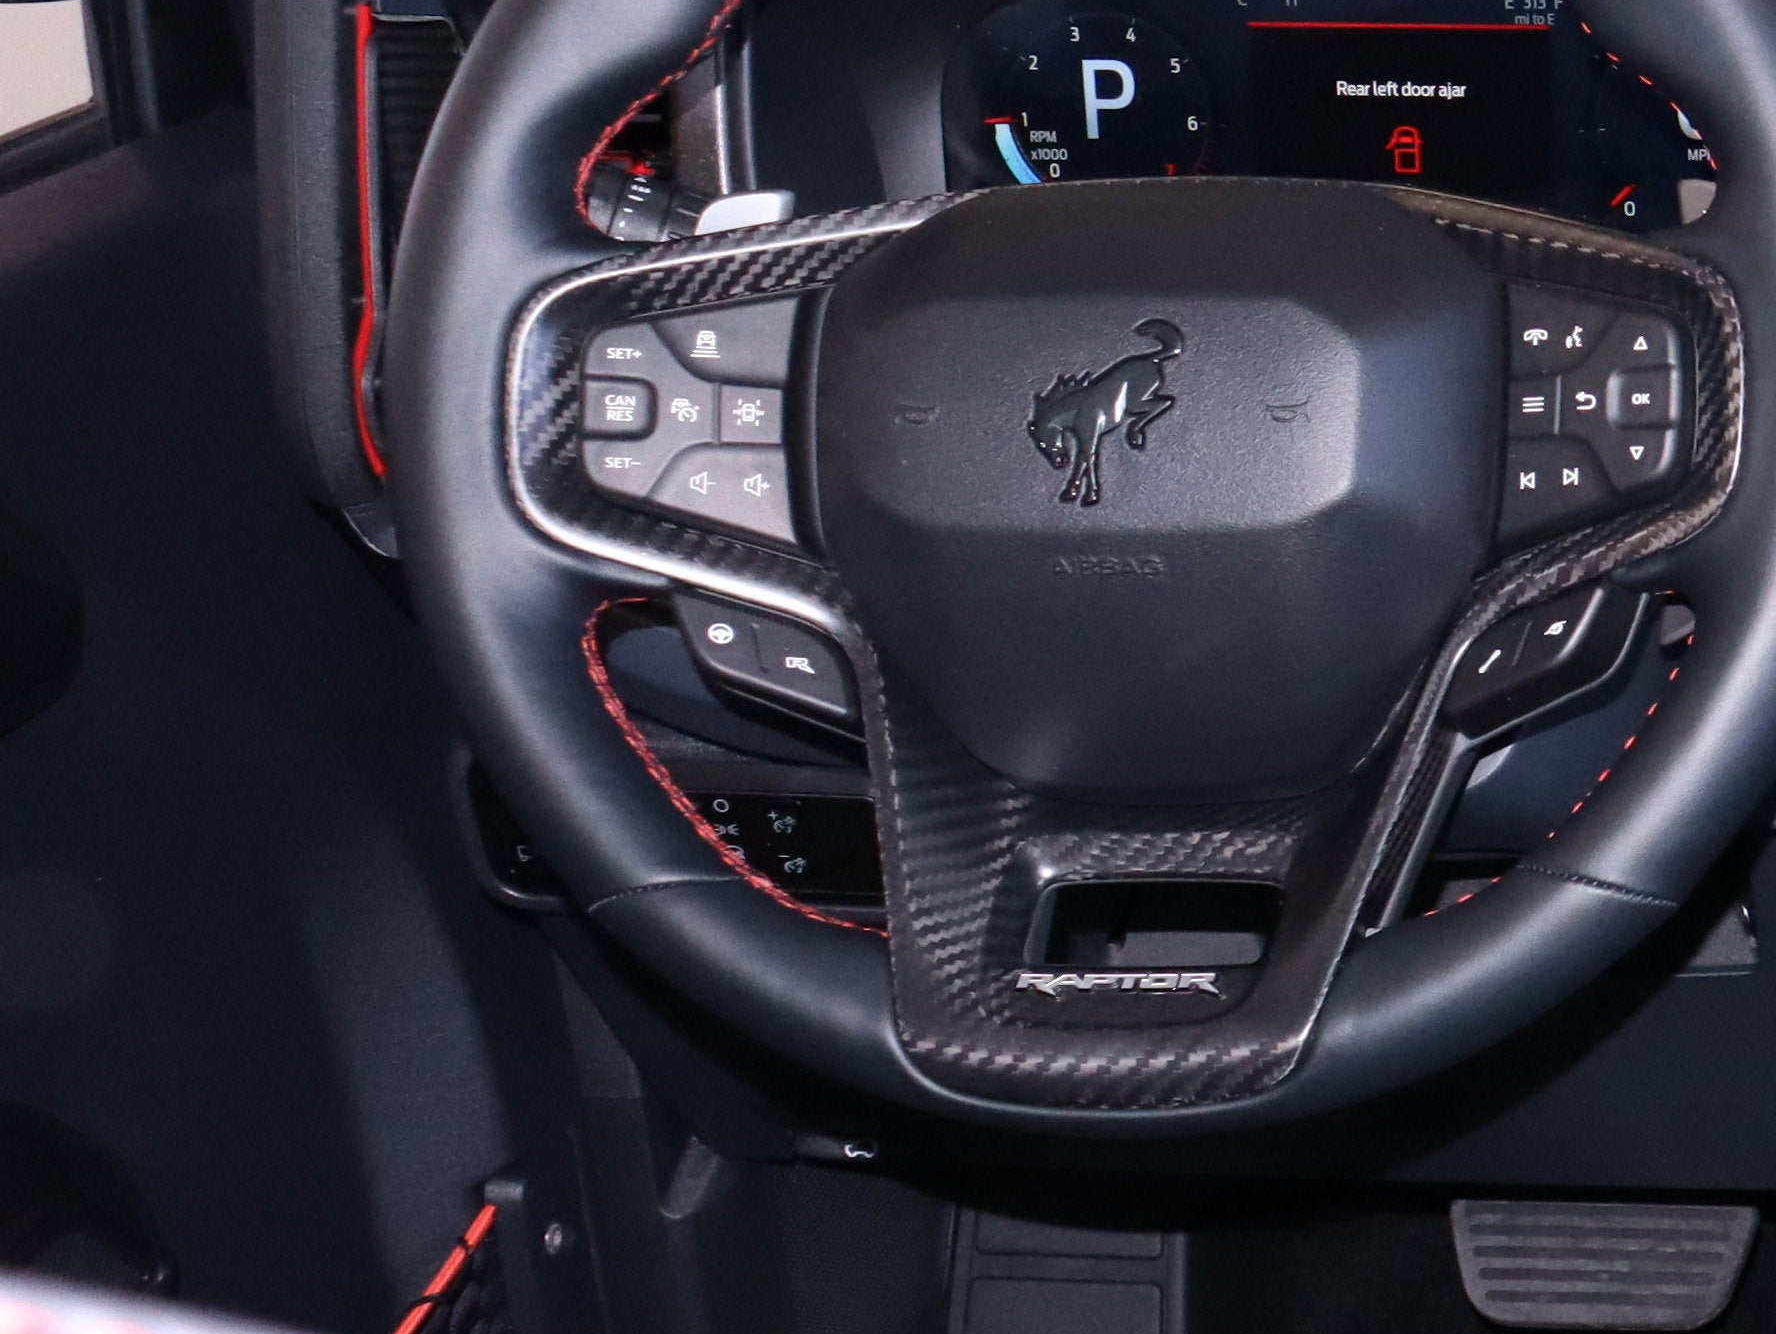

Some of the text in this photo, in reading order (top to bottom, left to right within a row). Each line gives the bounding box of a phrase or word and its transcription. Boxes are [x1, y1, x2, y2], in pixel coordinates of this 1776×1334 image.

[1514, 13, 1555, 25] mi to E
[1069, 27, 1080, 42] 3
[1126, 27, 1136, 43] 4
[1029, 55, 1039, 70] 2
[1170, 58, 1181, 73] 5
[1336, 81, 1467, 99] Rear left door ajar
[1081, 59, 1135, 139] P
[1021, 112, 1029, 127] 1
[1187, 116, 1198, 131] 6
[1030, 131, 1057, 143] RPM
[1031, 148, 1068, 161] x1000
[1049, 163, 1060, 178] 0
[1624, 201, 1636, 217] 0
[606, 347, 643, 359] SET+
[605, 395, 636, 408] CAN
[1631, 393, 1651, 405] OK
[606, 409, 634, 422] RES
[1014, 971, 1222, 999] RAPTOR
